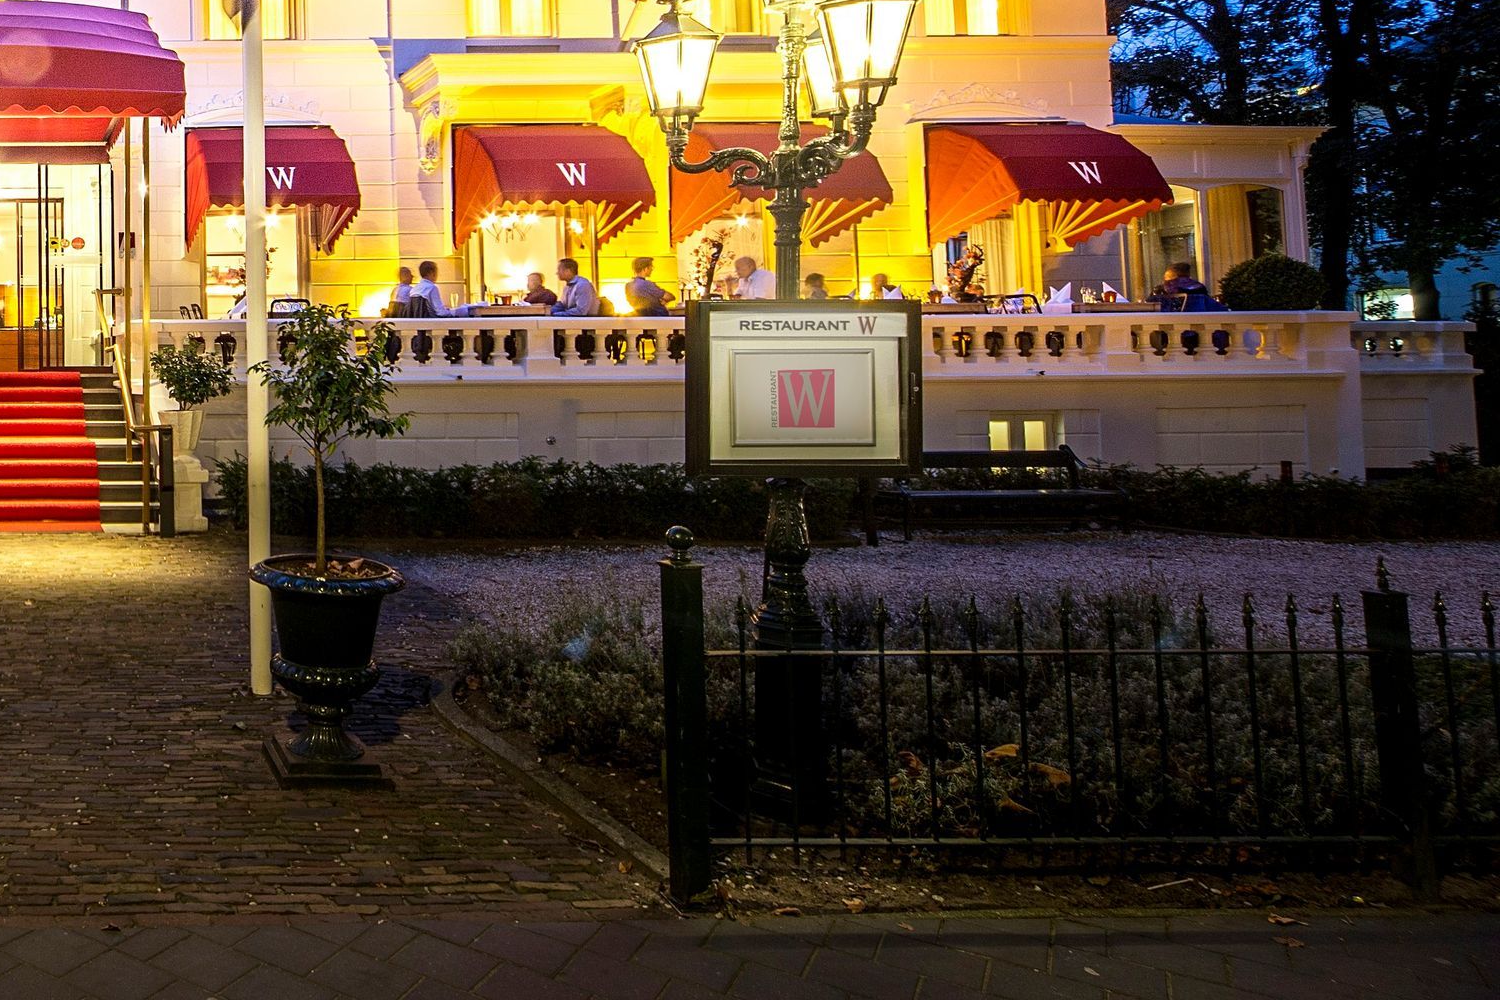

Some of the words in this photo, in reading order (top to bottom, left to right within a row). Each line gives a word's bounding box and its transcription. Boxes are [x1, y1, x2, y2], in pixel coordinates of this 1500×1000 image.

[266, 166, 296, 190] W
[555, 162, 587, 186] W
[1067, 161, 1102, 184] W
[739, 320, 850, 331] RESTAURANT
[857, 316, 878, 335] W
[770, 370, 778, 428] RESTAURANT
[779, 371, 833, 426] W
